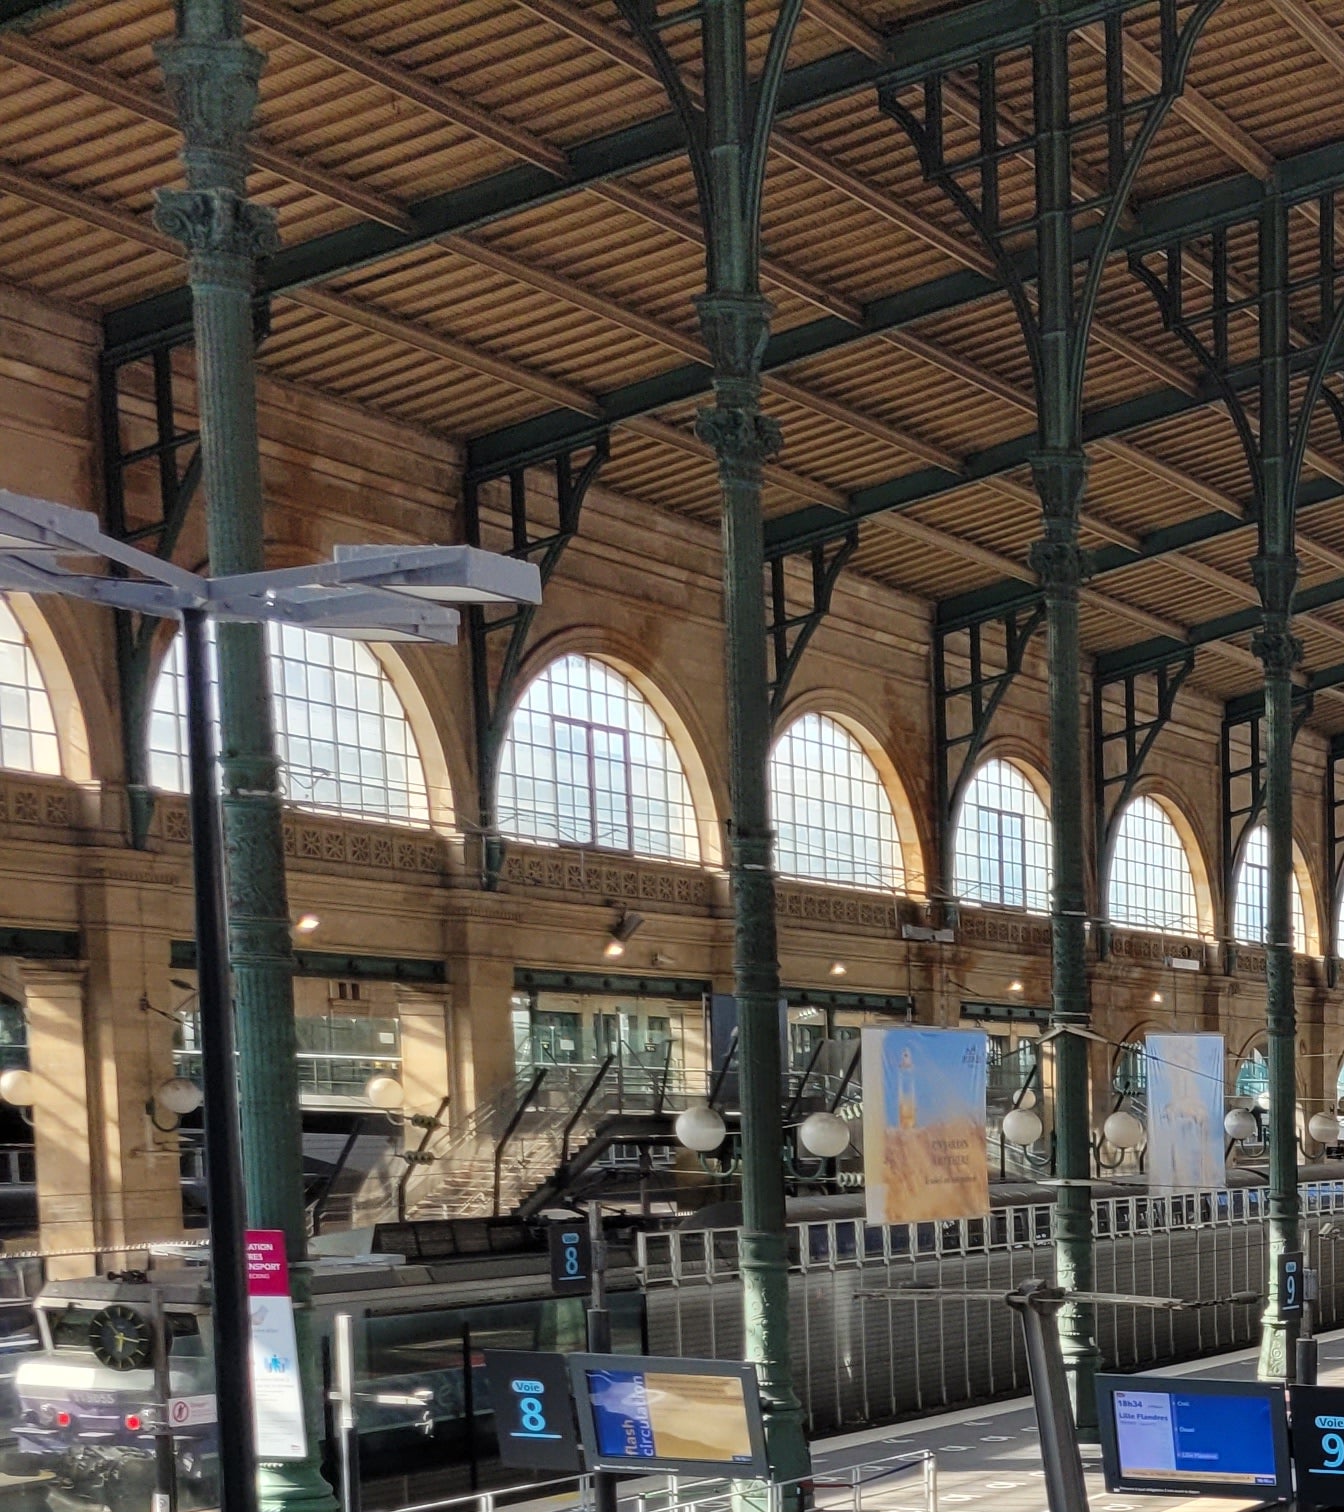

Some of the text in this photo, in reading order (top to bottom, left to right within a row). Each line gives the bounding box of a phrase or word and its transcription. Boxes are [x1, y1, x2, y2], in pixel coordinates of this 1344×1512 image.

[564, 1246, 578, 1275] 8
[1287, 1276, 1296, 1305] 9
[514, 1381, 542, 1392] Voie
[520, 1397, 546, 1432] 8
[633, 1375, 655, 1457] circulation
[1319, 1417, 1344, 1428] Voie
[622, 1419, 640, 1456] flash
